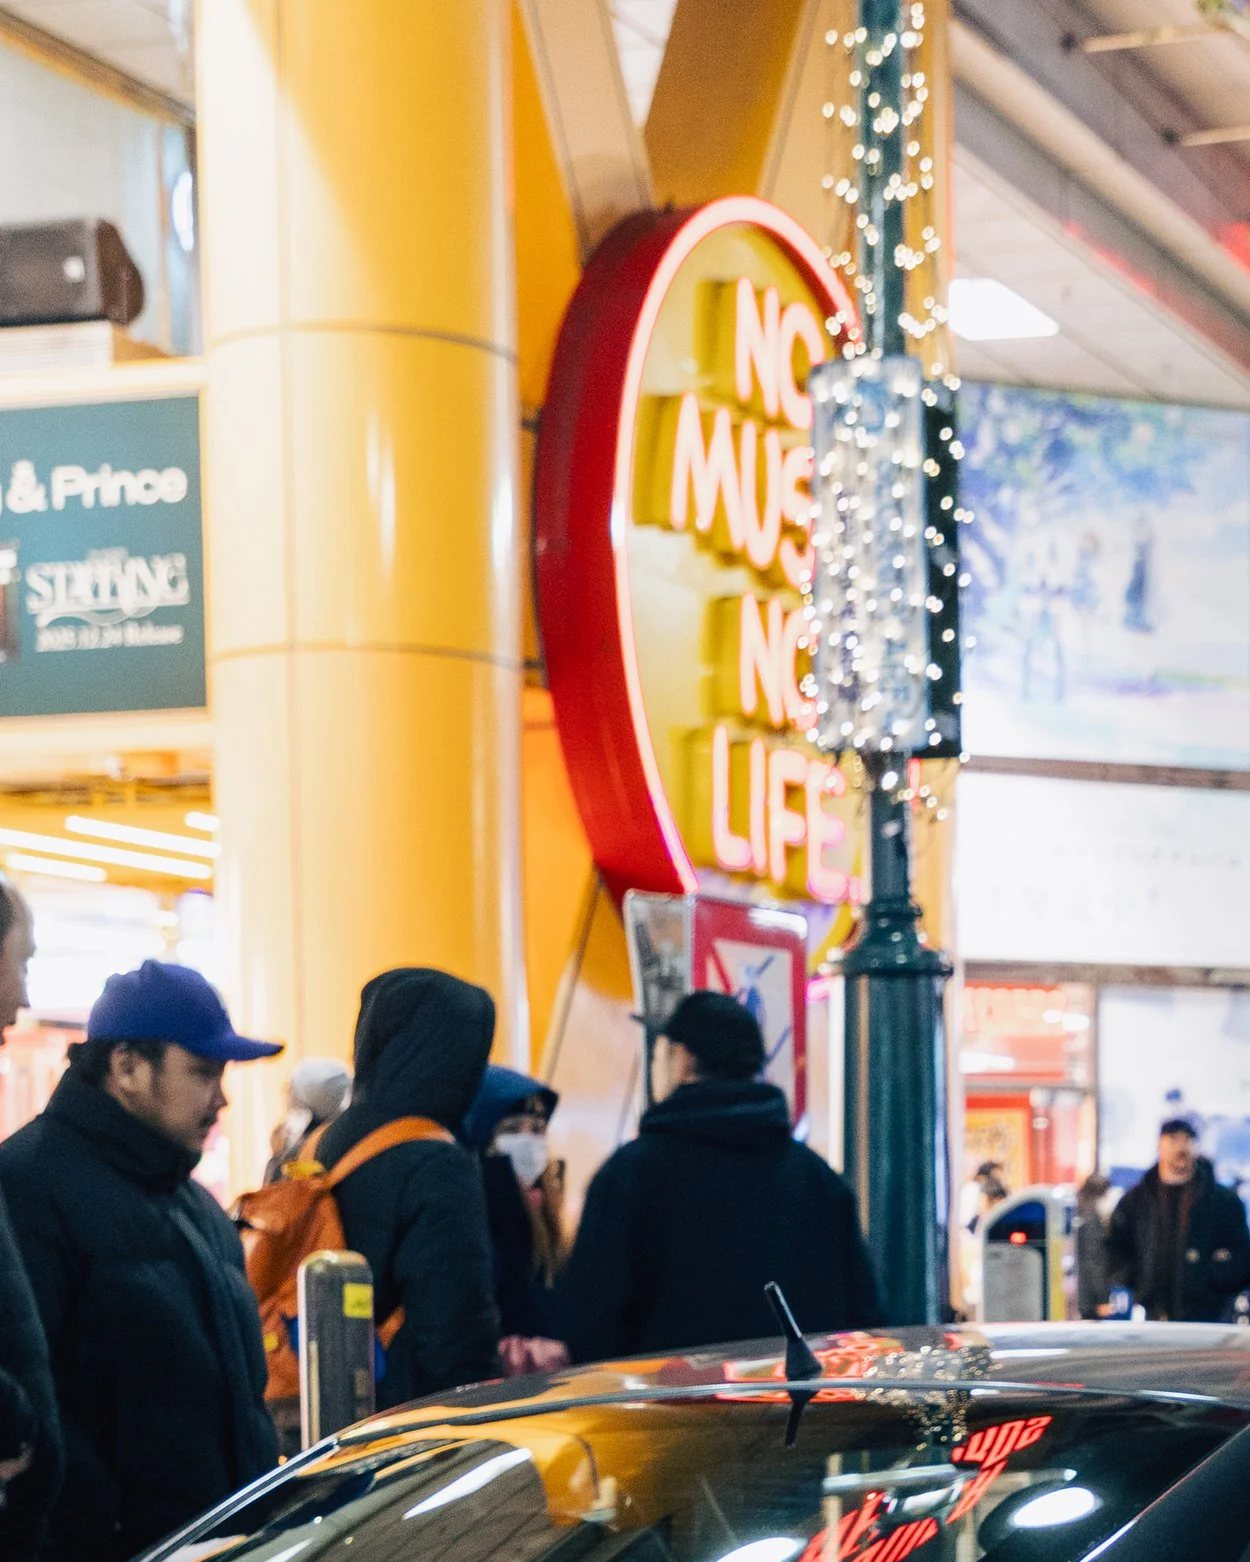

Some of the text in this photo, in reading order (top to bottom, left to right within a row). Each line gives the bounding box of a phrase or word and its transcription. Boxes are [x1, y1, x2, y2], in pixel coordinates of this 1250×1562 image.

[6, 459, 188, 514] & Prince
[670, 392, 816, 587] MUS
